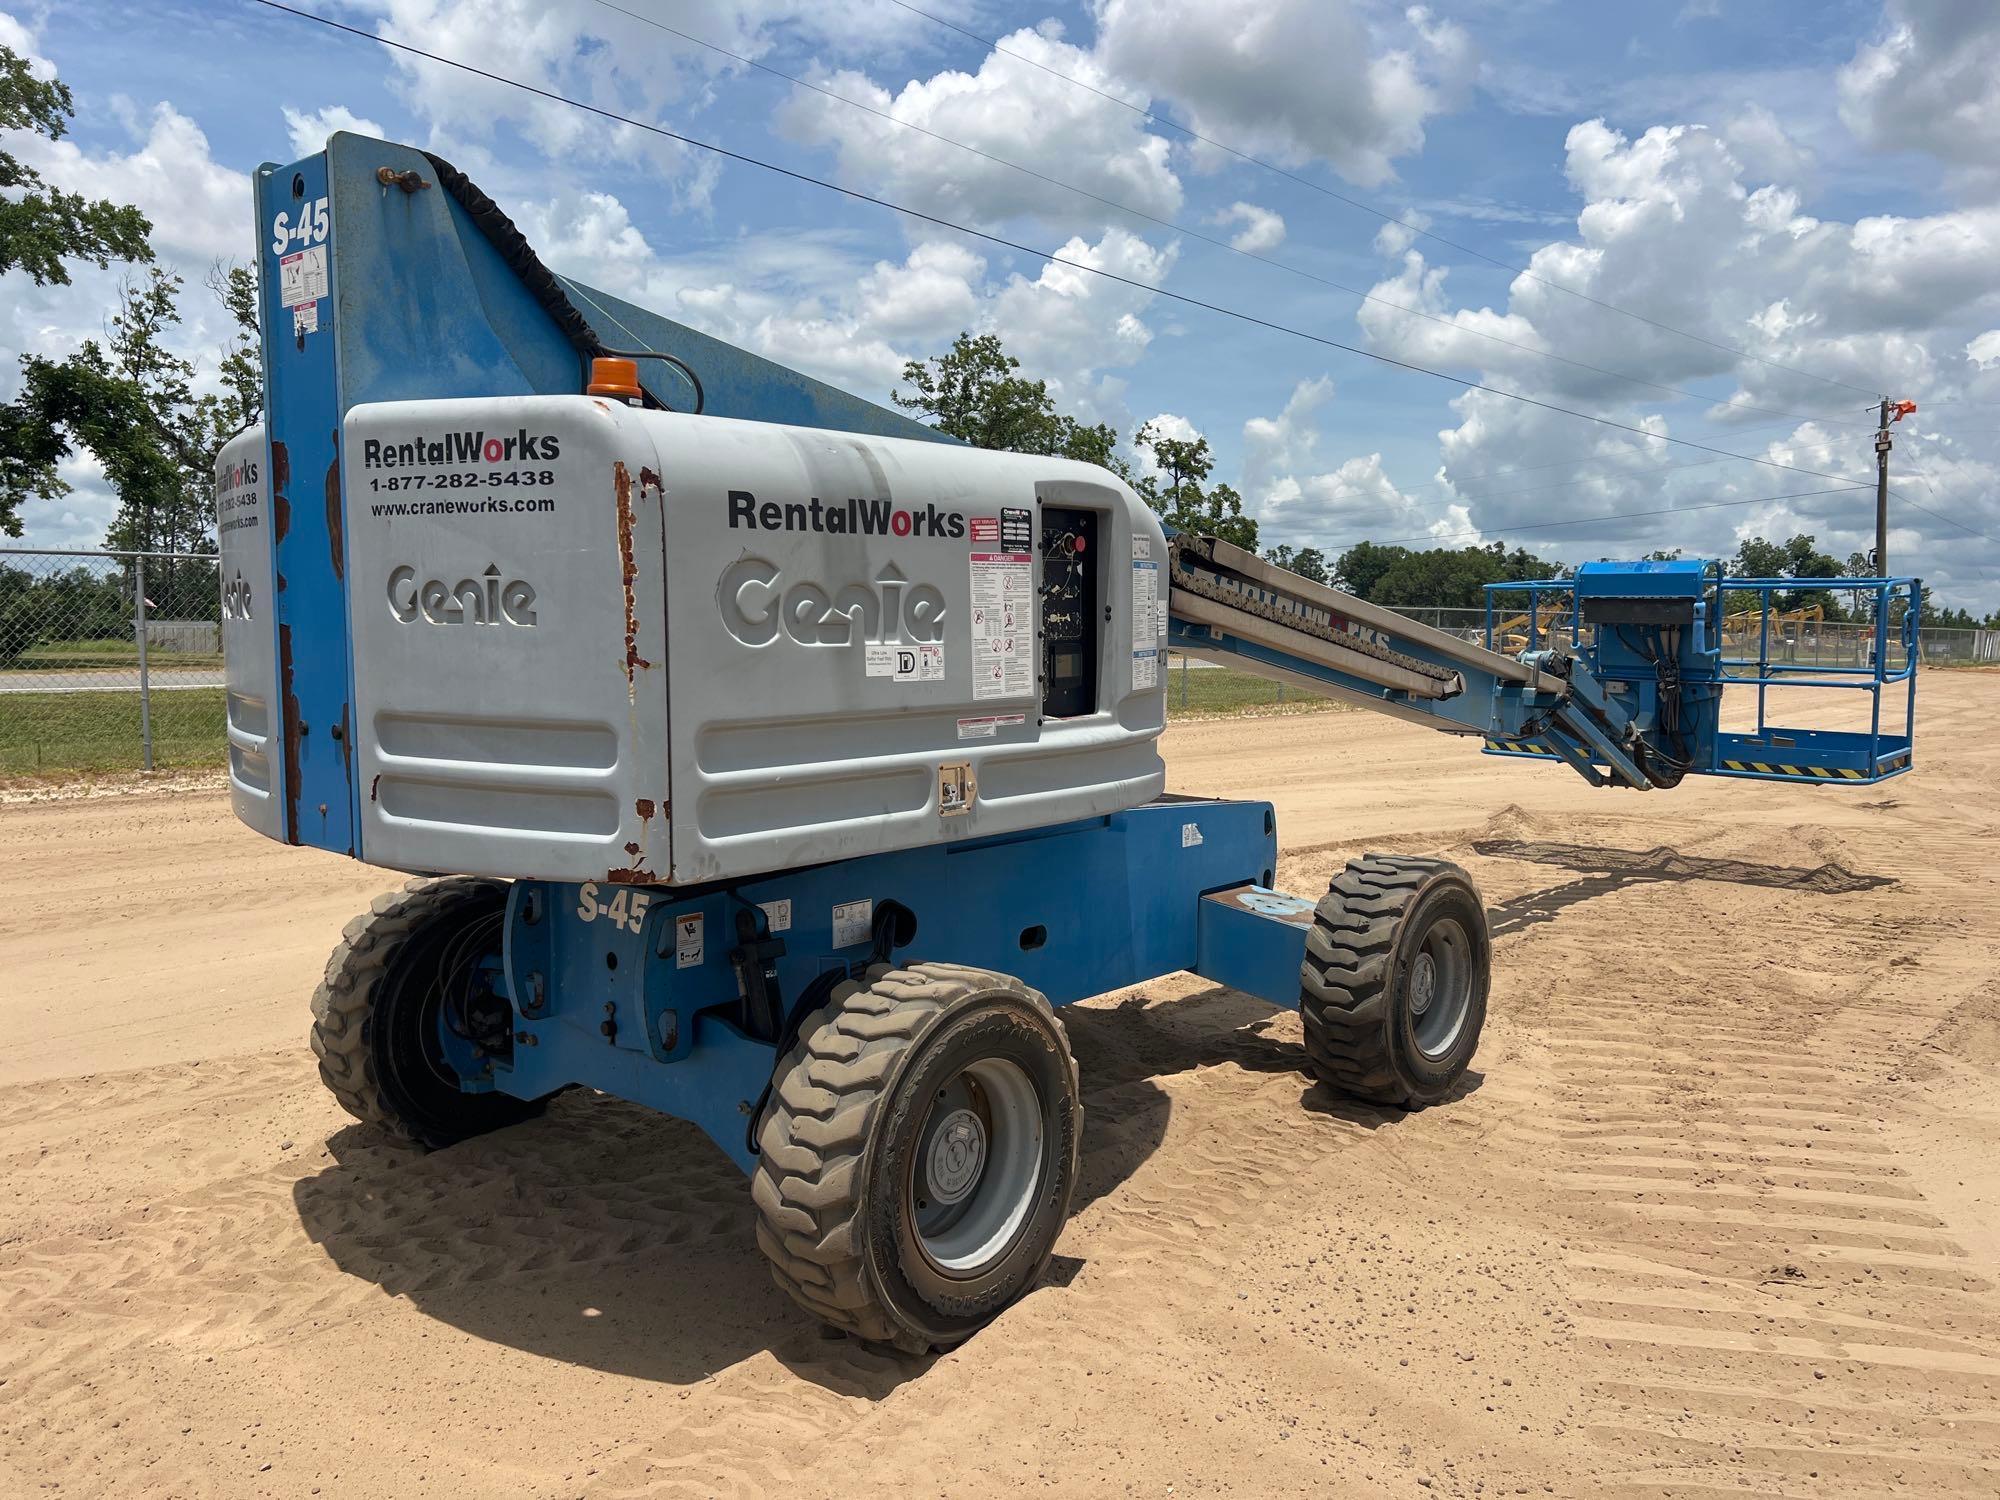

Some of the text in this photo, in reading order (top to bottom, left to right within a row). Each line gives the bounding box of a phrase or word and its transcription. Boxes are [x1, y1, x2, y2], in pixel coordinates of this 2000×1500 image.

[272, 196, 329, 255] S-45
[364, 428, 560, 469] RentalWorks
[369, 470, 555, 492] 1-877-282-5438
[371, 496, 555, 517] www.craneworks.com
[727, 490, 965, 538] RentalWorks
[221, 567, 253, 621] enie
[386, 562, 537, 627] Genie
[717, 559, 947, 648] Genie
[897, 651, 915, 673] D
[577, 882, 650, 935] S-45
